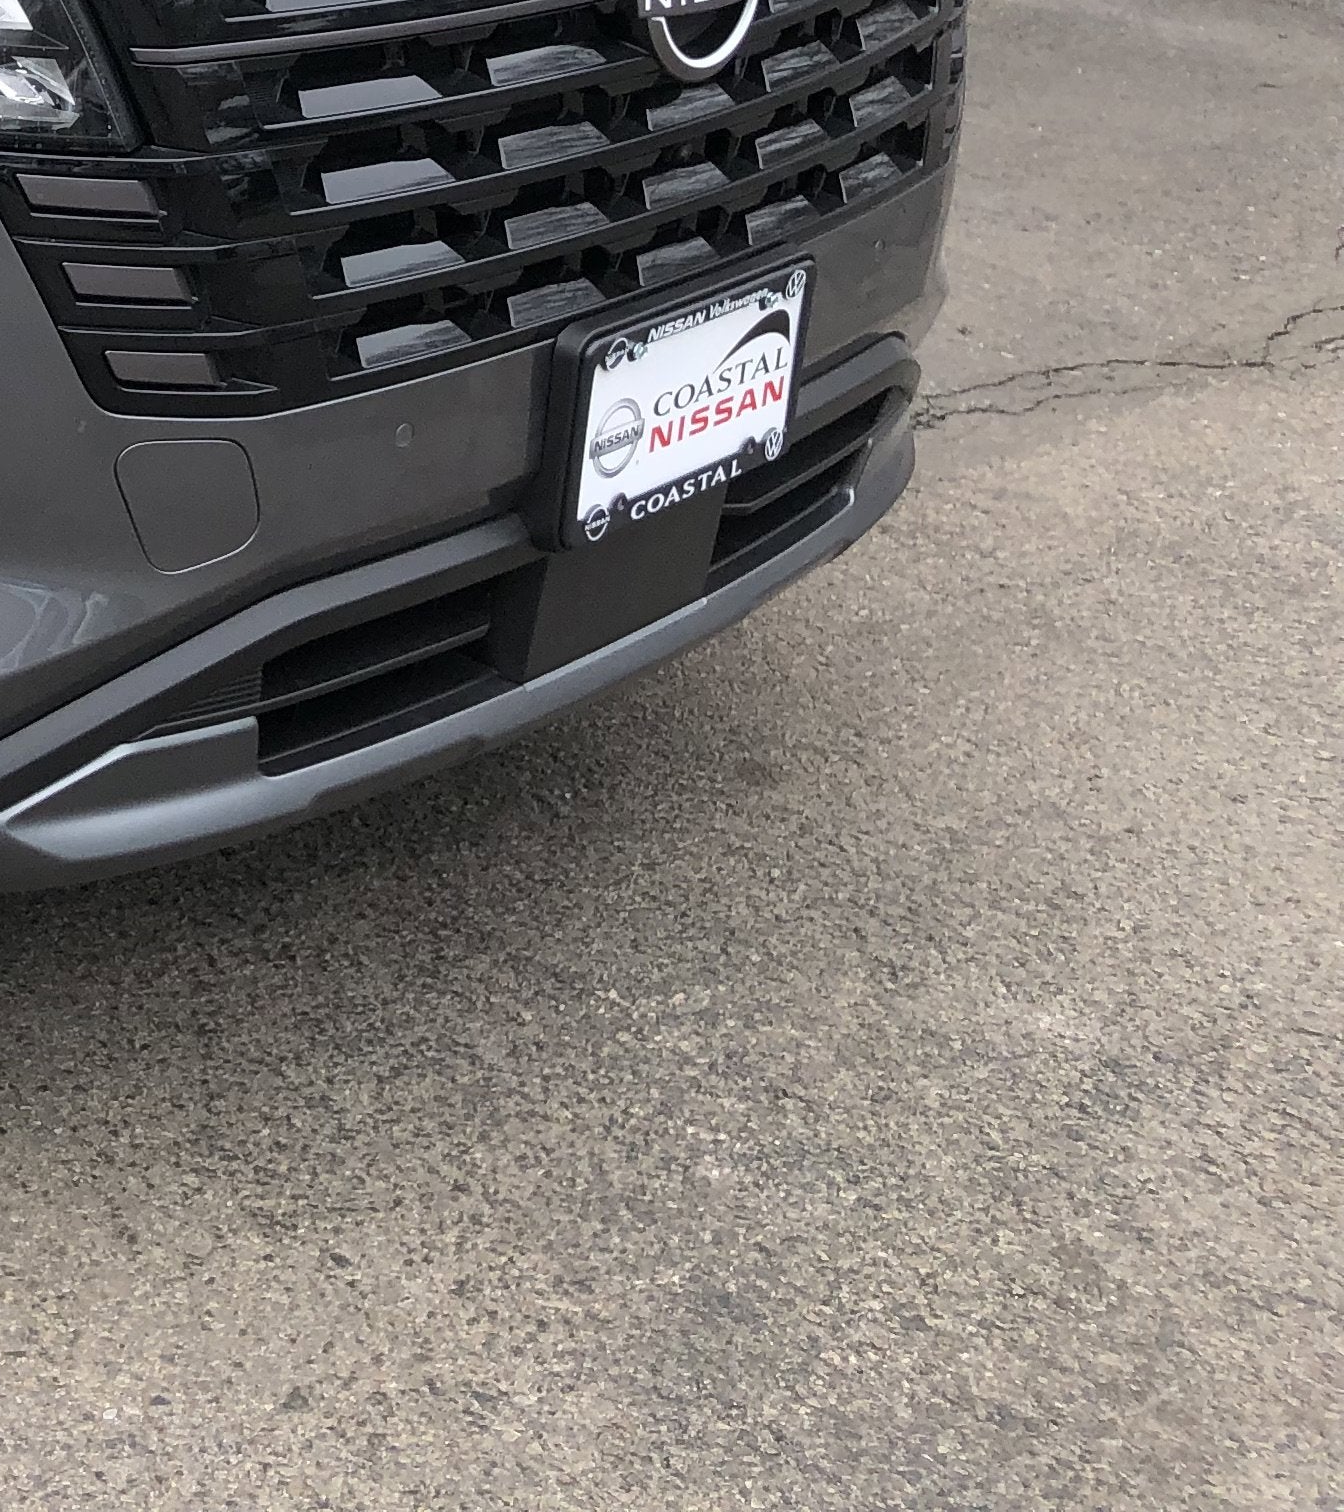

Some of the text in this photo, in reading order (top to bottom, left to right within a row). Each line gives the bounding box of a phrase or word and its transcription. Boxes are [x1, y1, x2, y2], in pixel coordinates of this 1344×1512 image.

[647, 309, 707, 343] NISSAN
[653, 346, 788, 417] COASTAL
[593, 424, 641, 453] NISSAN
[649, 376, 785, 454] NISSAN
[630, 459, 743, 520] COASTAL
